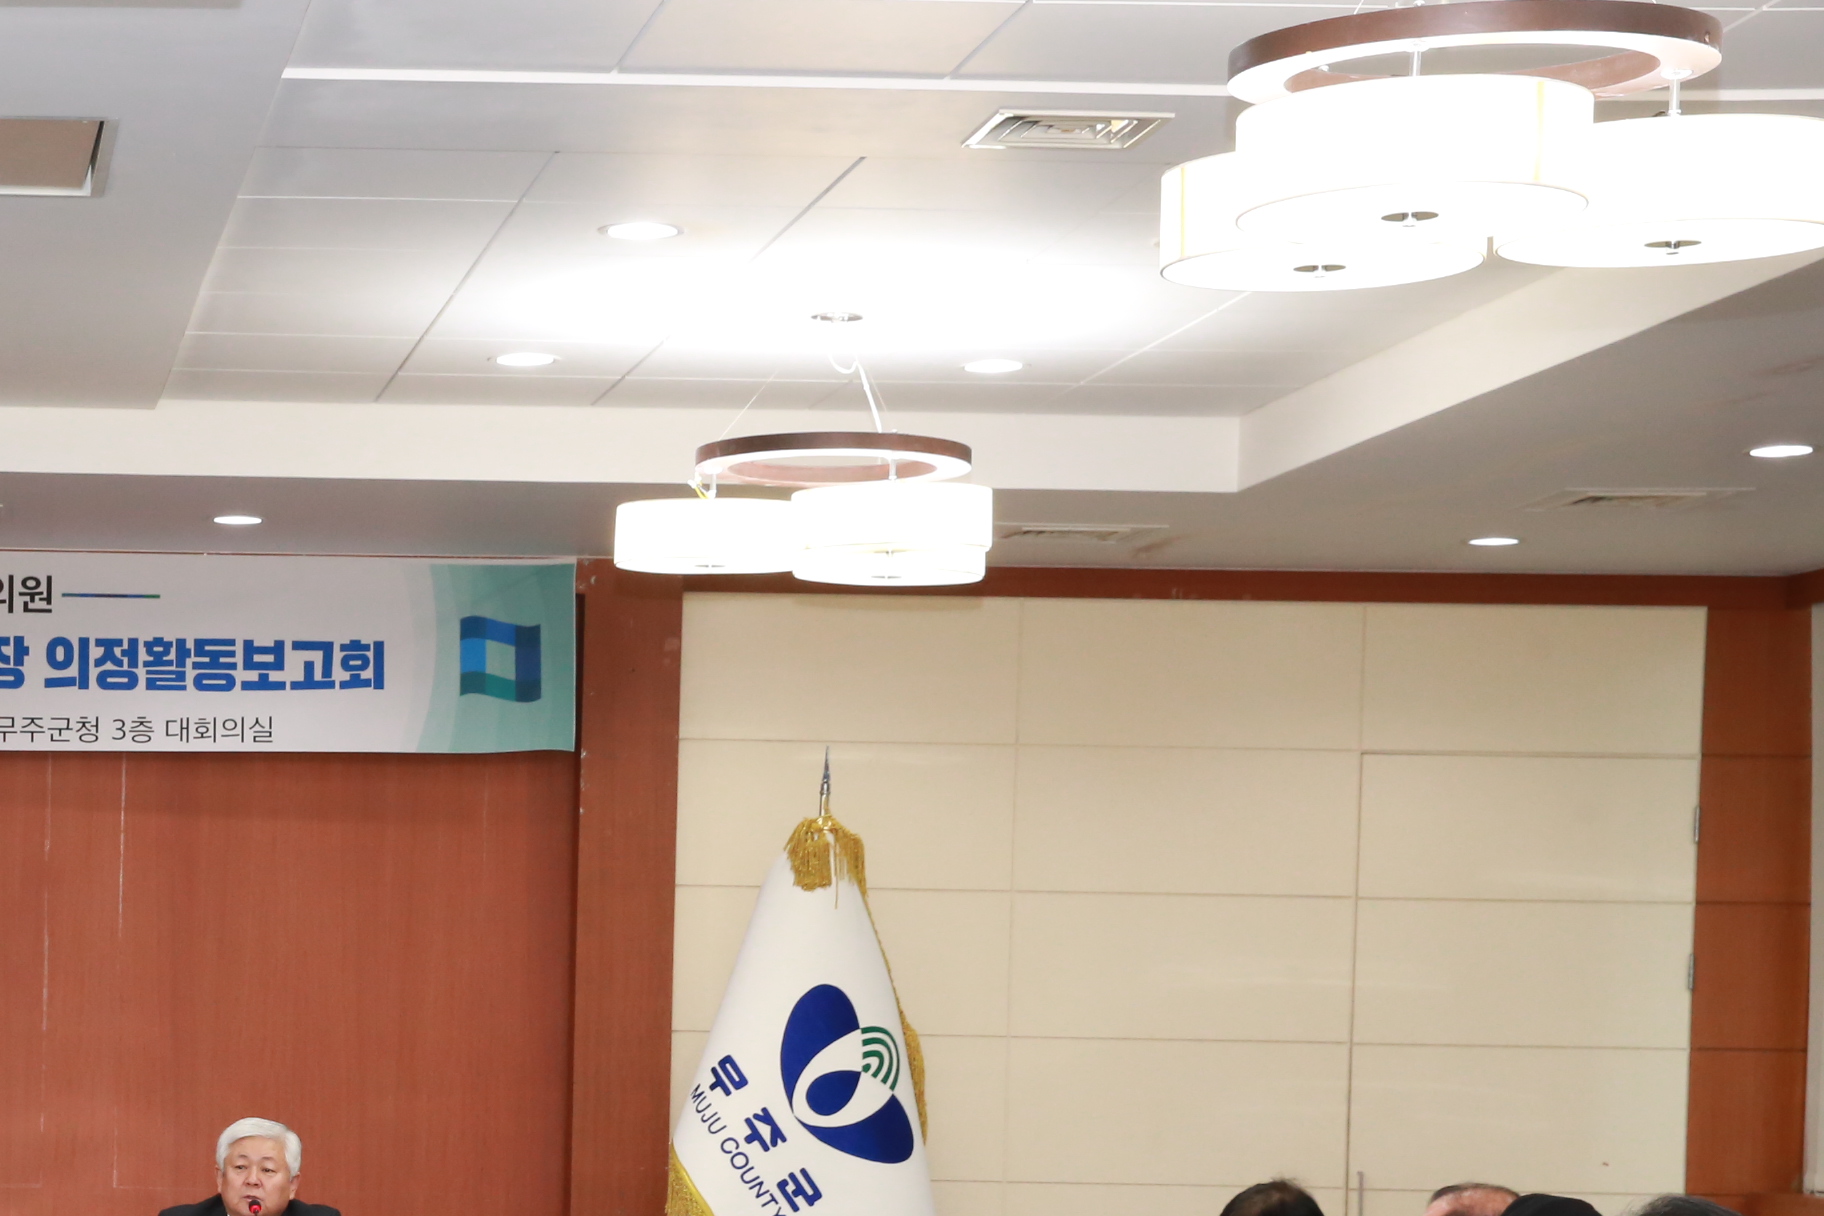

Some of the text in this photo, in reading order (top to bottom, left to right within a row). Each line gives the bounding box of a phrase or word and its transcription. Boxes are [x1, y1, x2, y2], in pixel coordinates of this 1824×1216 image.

[44, 636, 385, 692] 의정활동보고회
[111, 716, 155, 743] 3층
[165, 716, 274, 743] 대회의실
[690, 1084, 727, 1135] MUJU
[709, 1054, 823, 1212] 무주군
